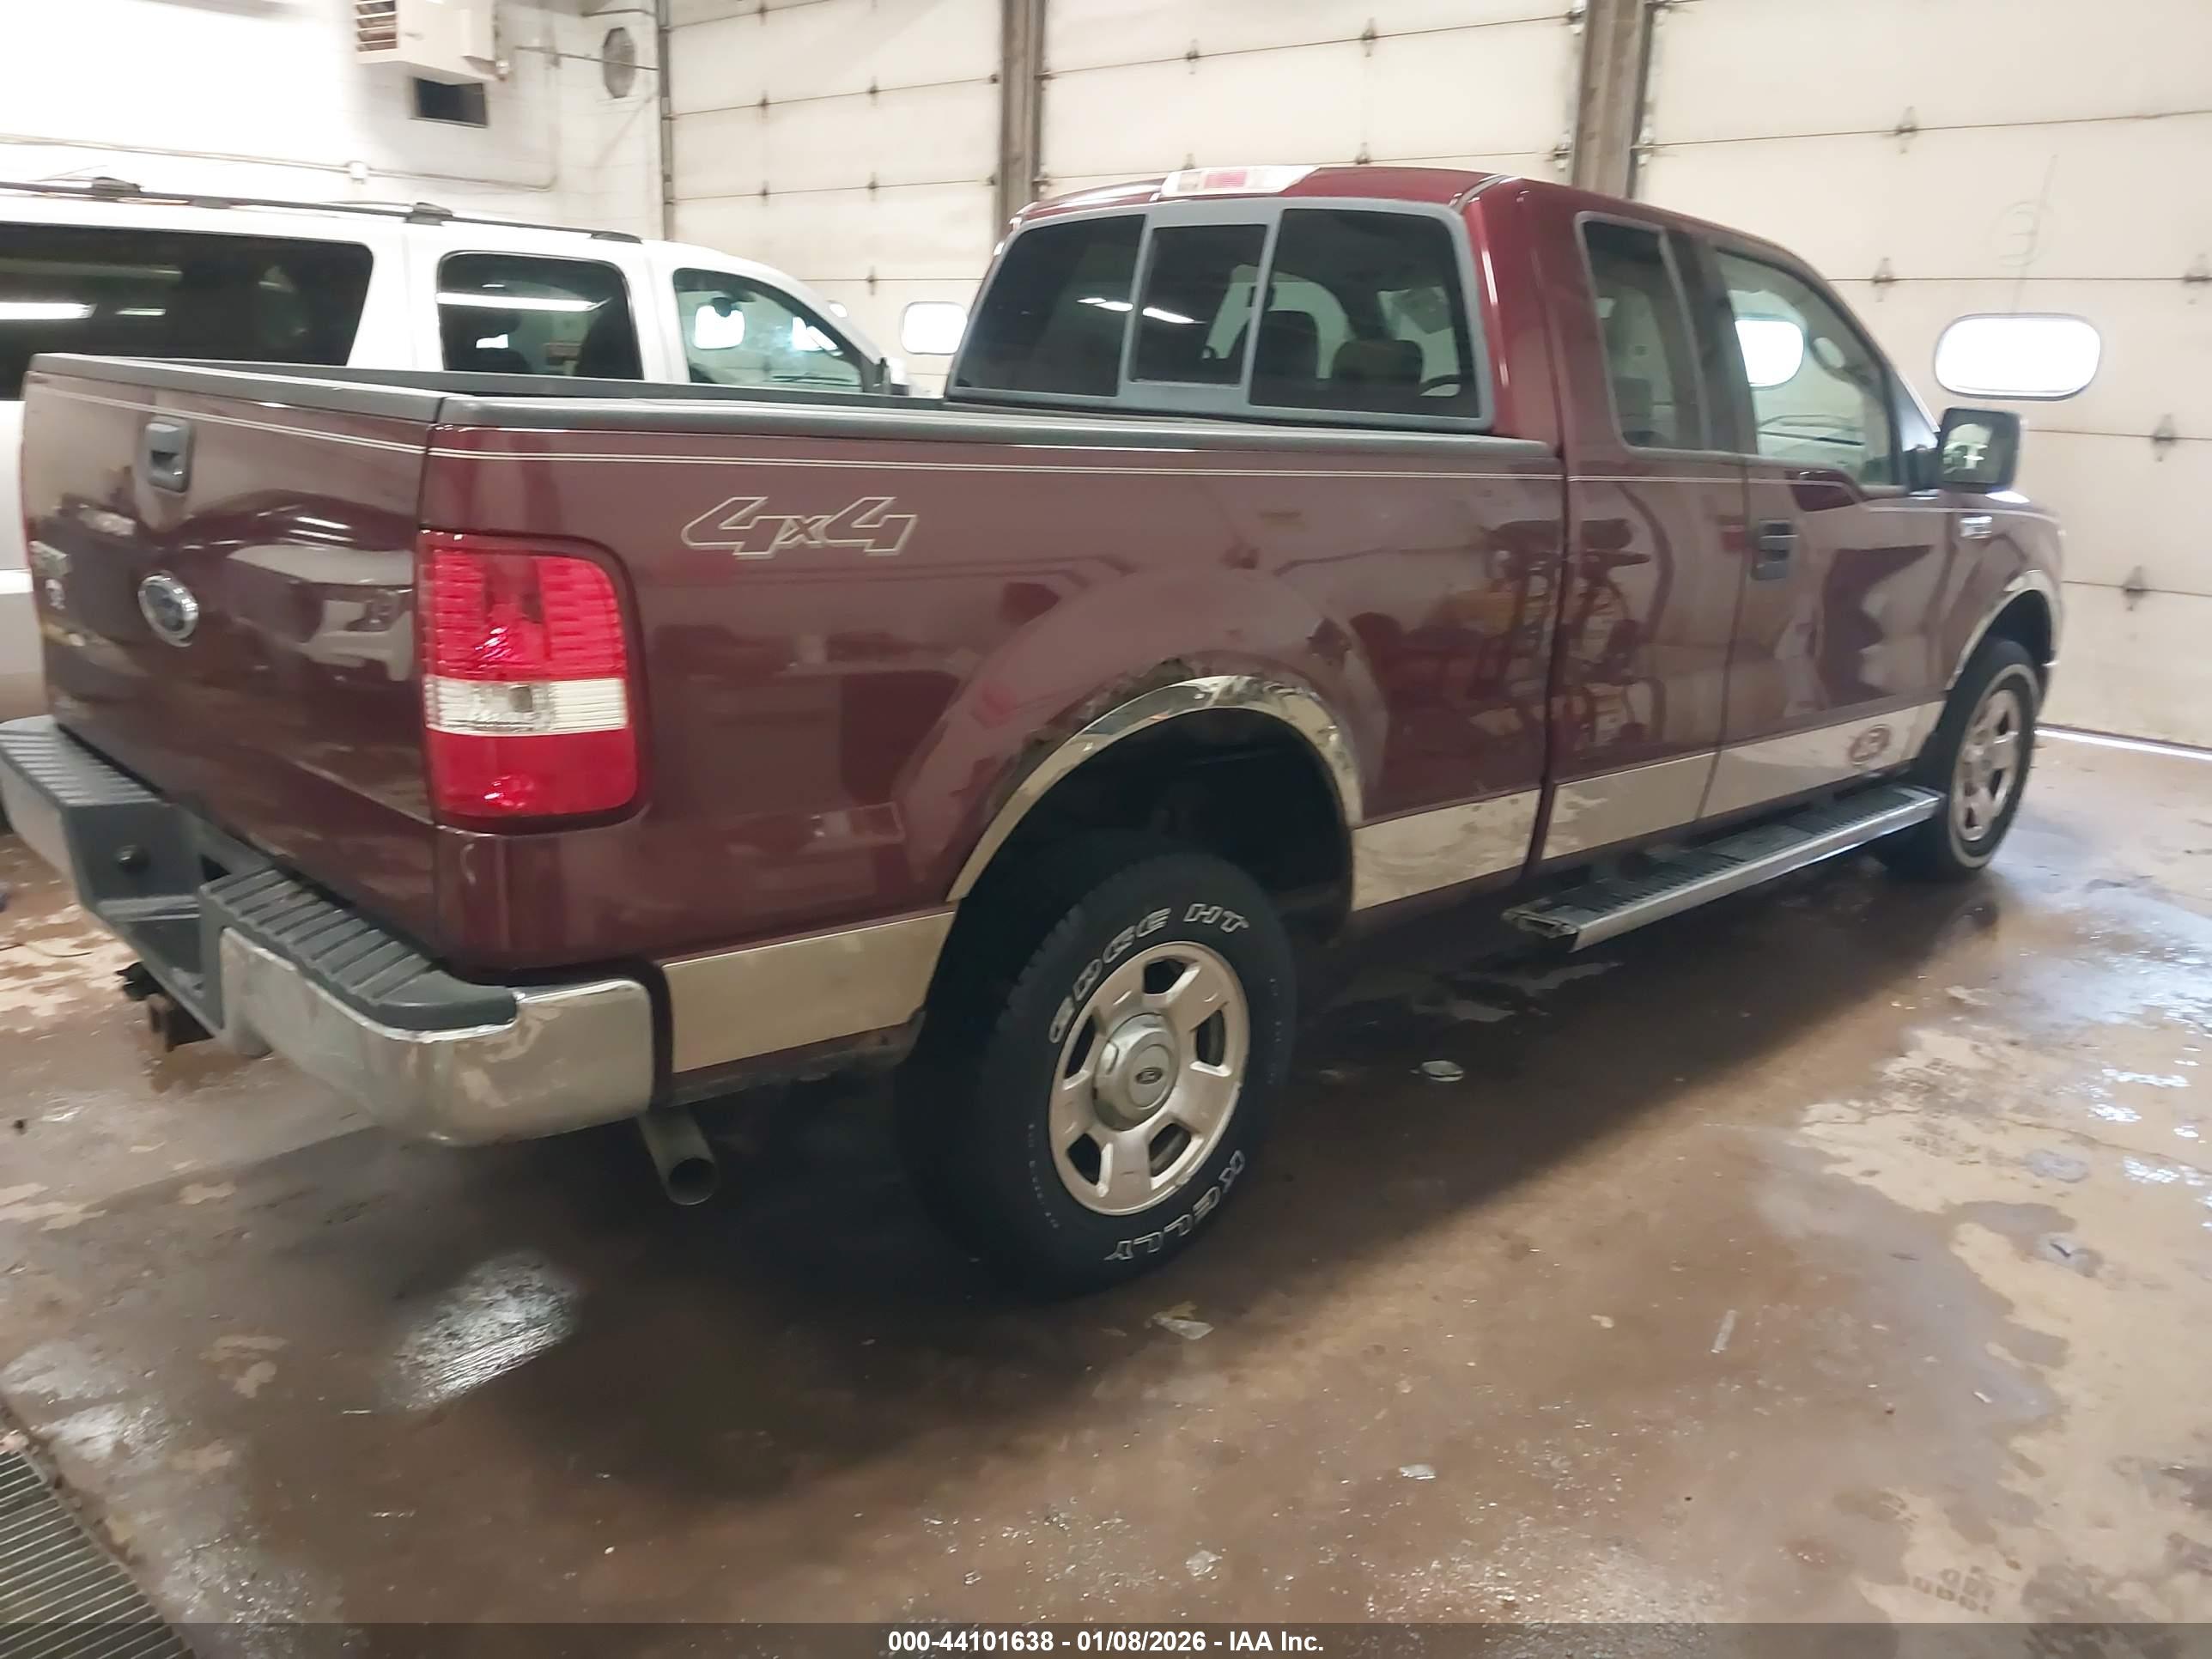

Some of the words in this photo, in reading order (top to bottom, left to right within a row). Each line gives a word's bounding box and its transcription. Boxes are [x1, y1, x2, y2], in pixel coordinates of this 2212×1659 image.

[681, 496, 919, 560] 4x4
[1182, 902, 1250, 933] HT
[1103, 1150, 1246, 1261] KELLY
